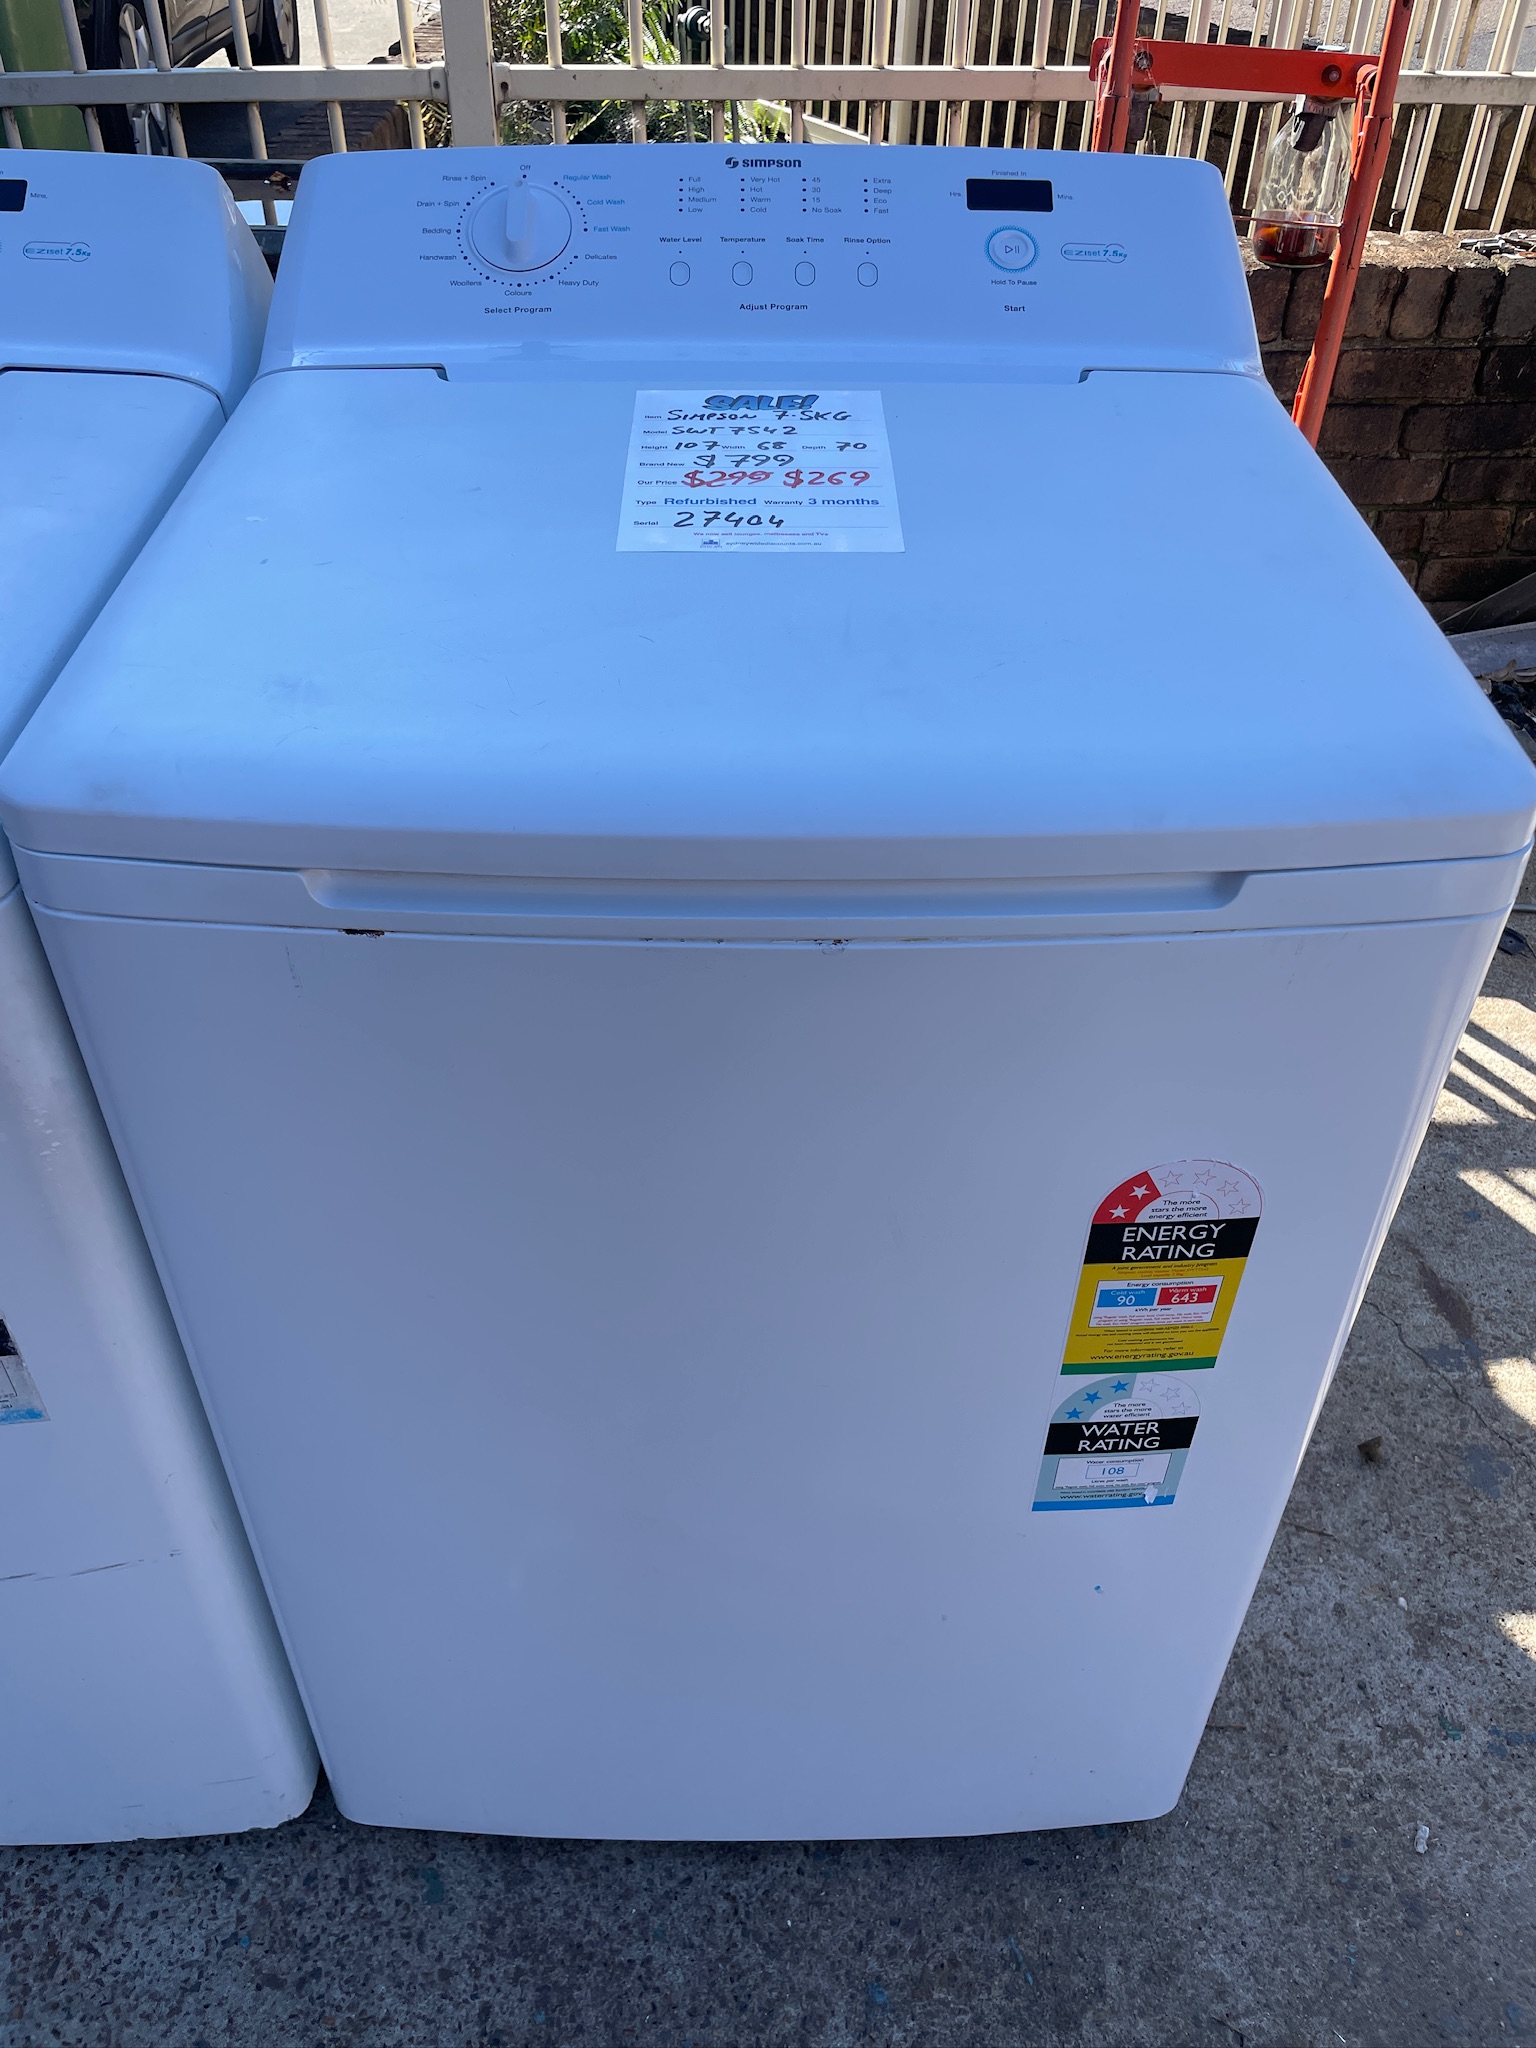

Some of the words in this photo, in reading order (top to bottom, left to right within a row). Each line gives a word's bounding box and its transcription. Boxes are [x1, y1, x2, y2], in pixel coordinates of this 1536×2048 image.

[742, 159, 801, 168] SIMPSON
[514, 306, 552, 315] Program
[702, 394, 820, 410] SALE!
[675, 441, 720, 450] 107
[757, 442, 787, 450] 68
[836, 442, 867, 452] 70
[783, 469, 870, 488] $269
[674, 510, 784, 528] 27404
[1122, 1223, 1226, 1242] ENERGY
[1122, 1243, 1215, 1261] RATING
[1118, 1296, 1135, 1305] 90
[1171, 1293, 1198, 1303] 643
[1090, 1351, 1194, 1360] www.energyrating.gov.au
[1082, 1422, 1159, 1437] WATER
[1078, 1437, 1160, 1451] RATING
[1102, 1467, 1124, 1475] 108
